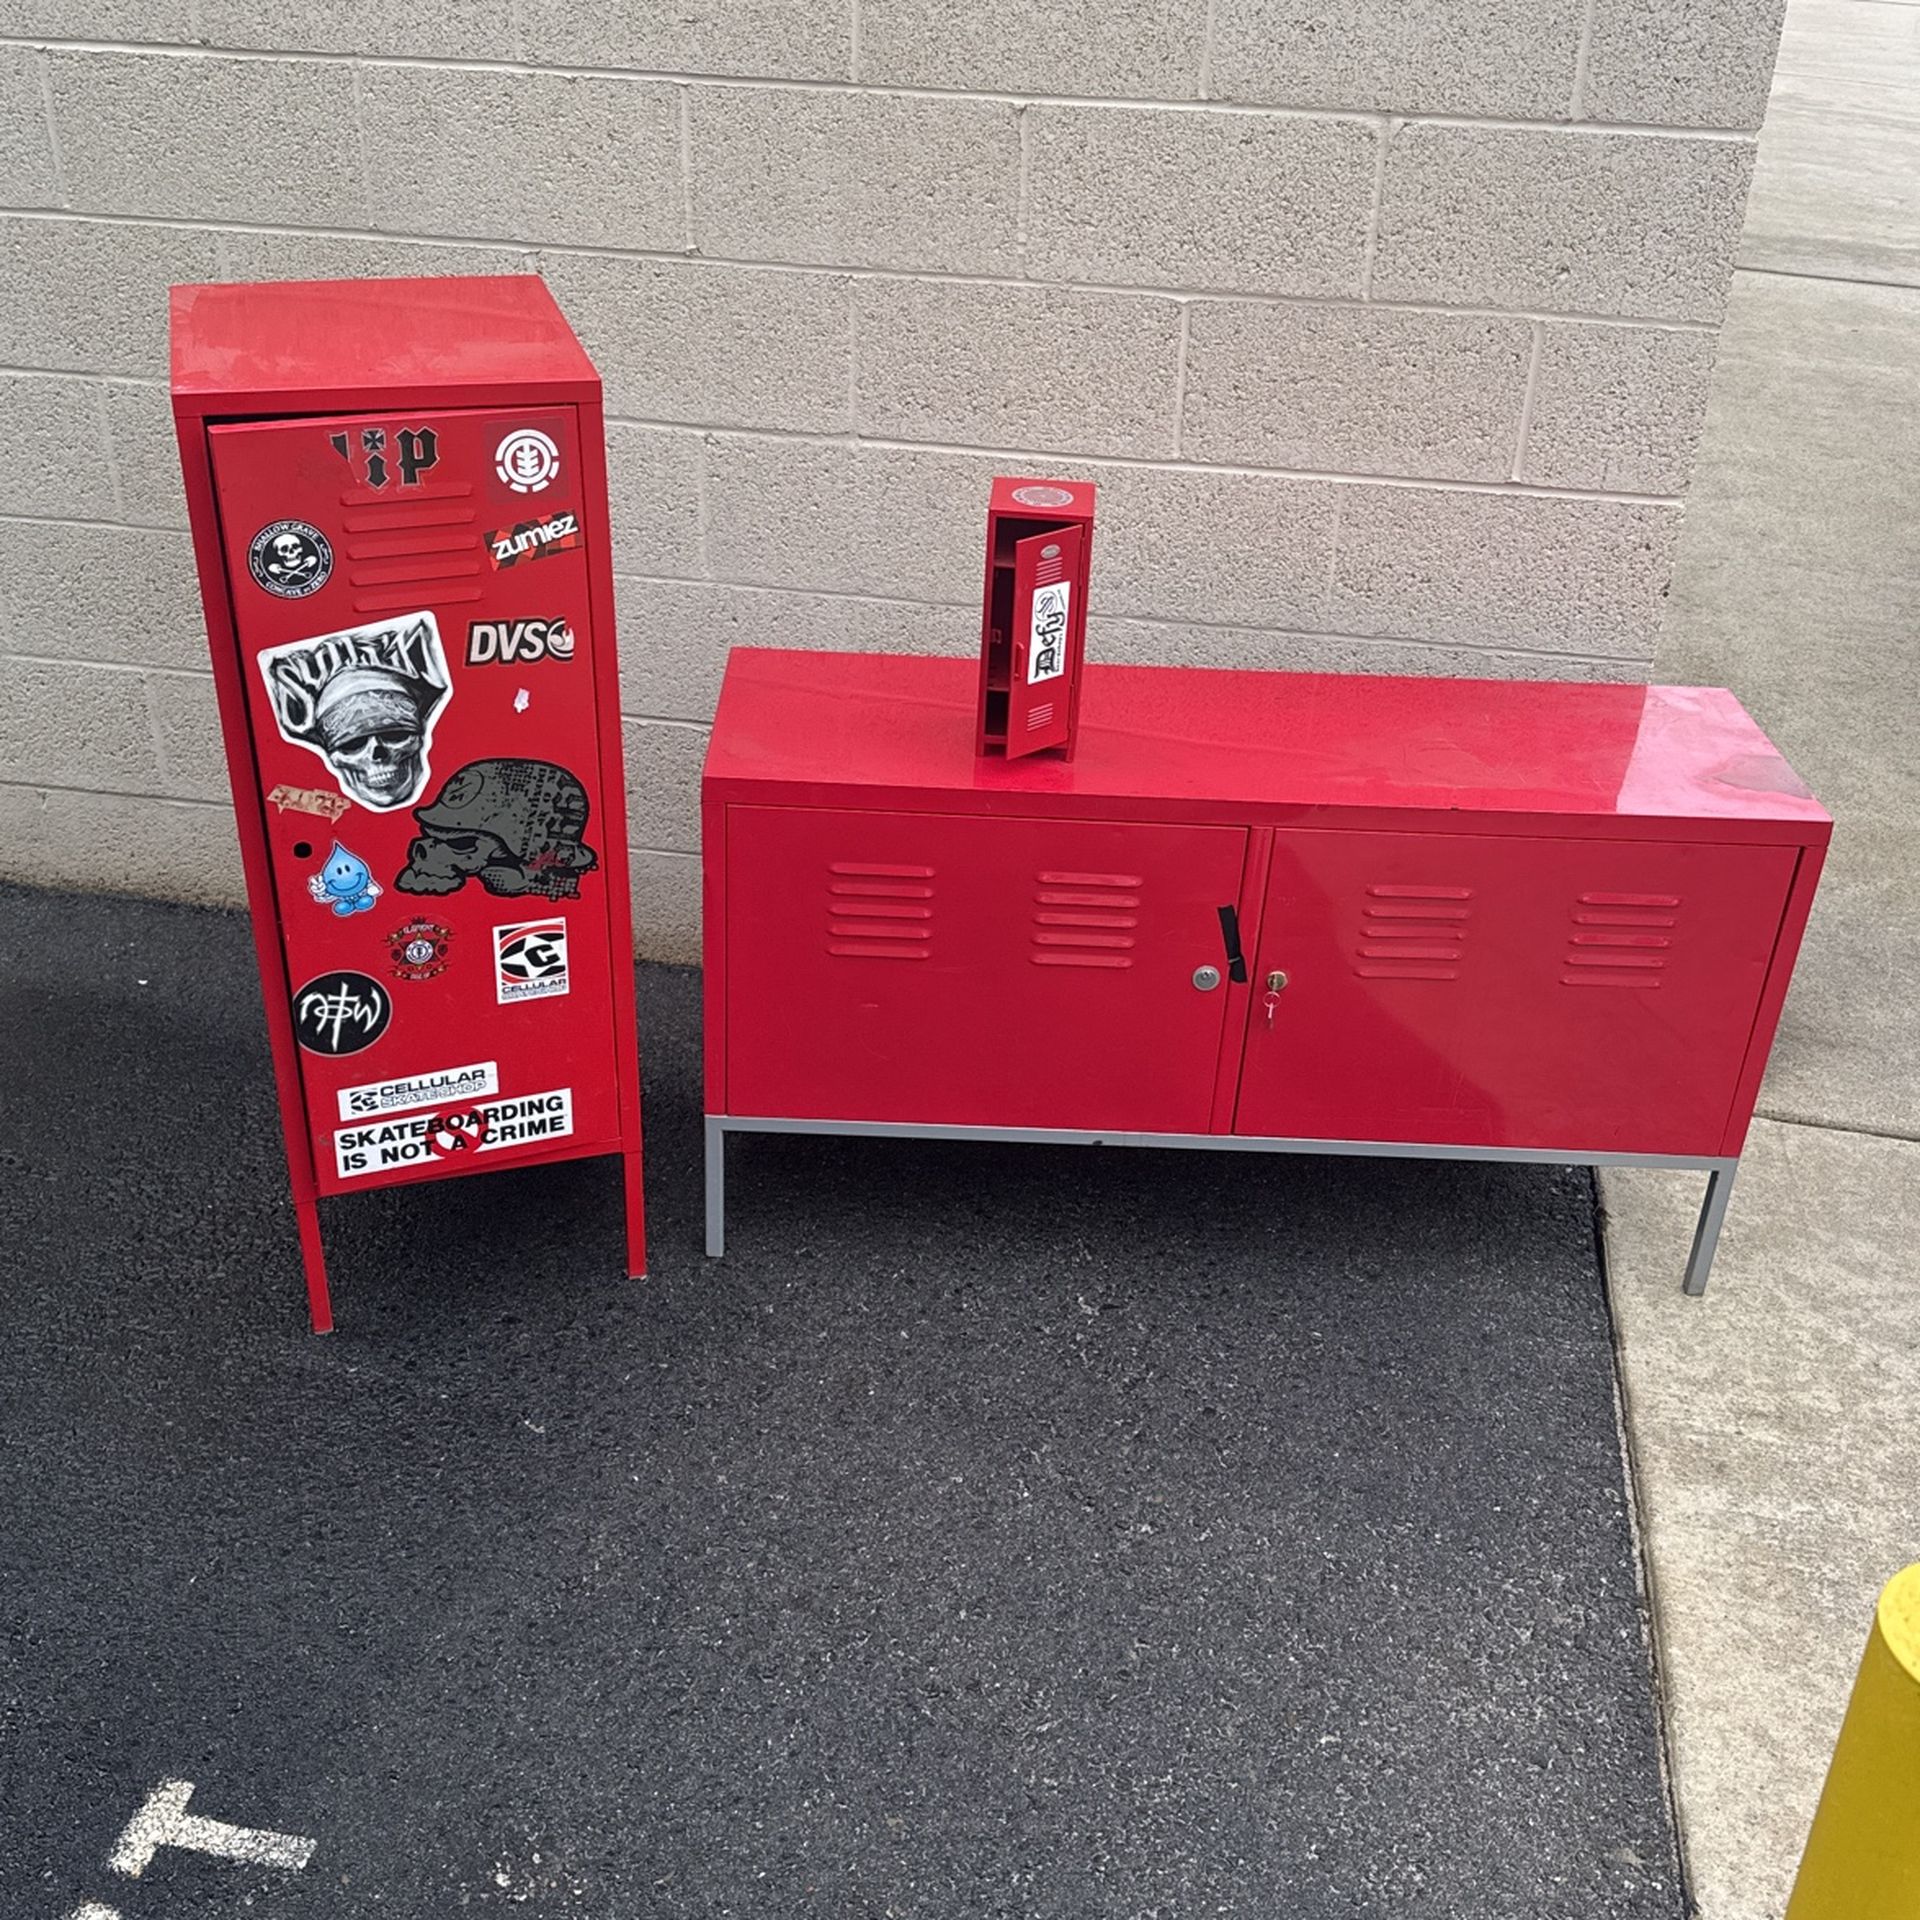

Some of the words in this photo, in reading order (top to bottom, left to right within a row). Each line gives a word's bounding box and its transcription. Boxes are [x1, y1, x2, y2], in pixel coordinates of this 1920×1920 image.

[491, 515, 579, 561] zumiez
[469, 620, 548, 663] DVS
[1033, 610, 1066, 679] Defy
[501, 978, 567, 995] CELLULAR
[380, 1068, 486, 1097] CELLULAR
[380, 1079, 488, 1109] SKATESHOP
[338, 1095, 565, 1152] SKATEBOARDING
[342, 1152, 368, 1172] IS
[381, 1140, 436, 1165] NOT
[449, 1134, 469, 1152] A
[480, 1115, 566, 1145] CRIME
